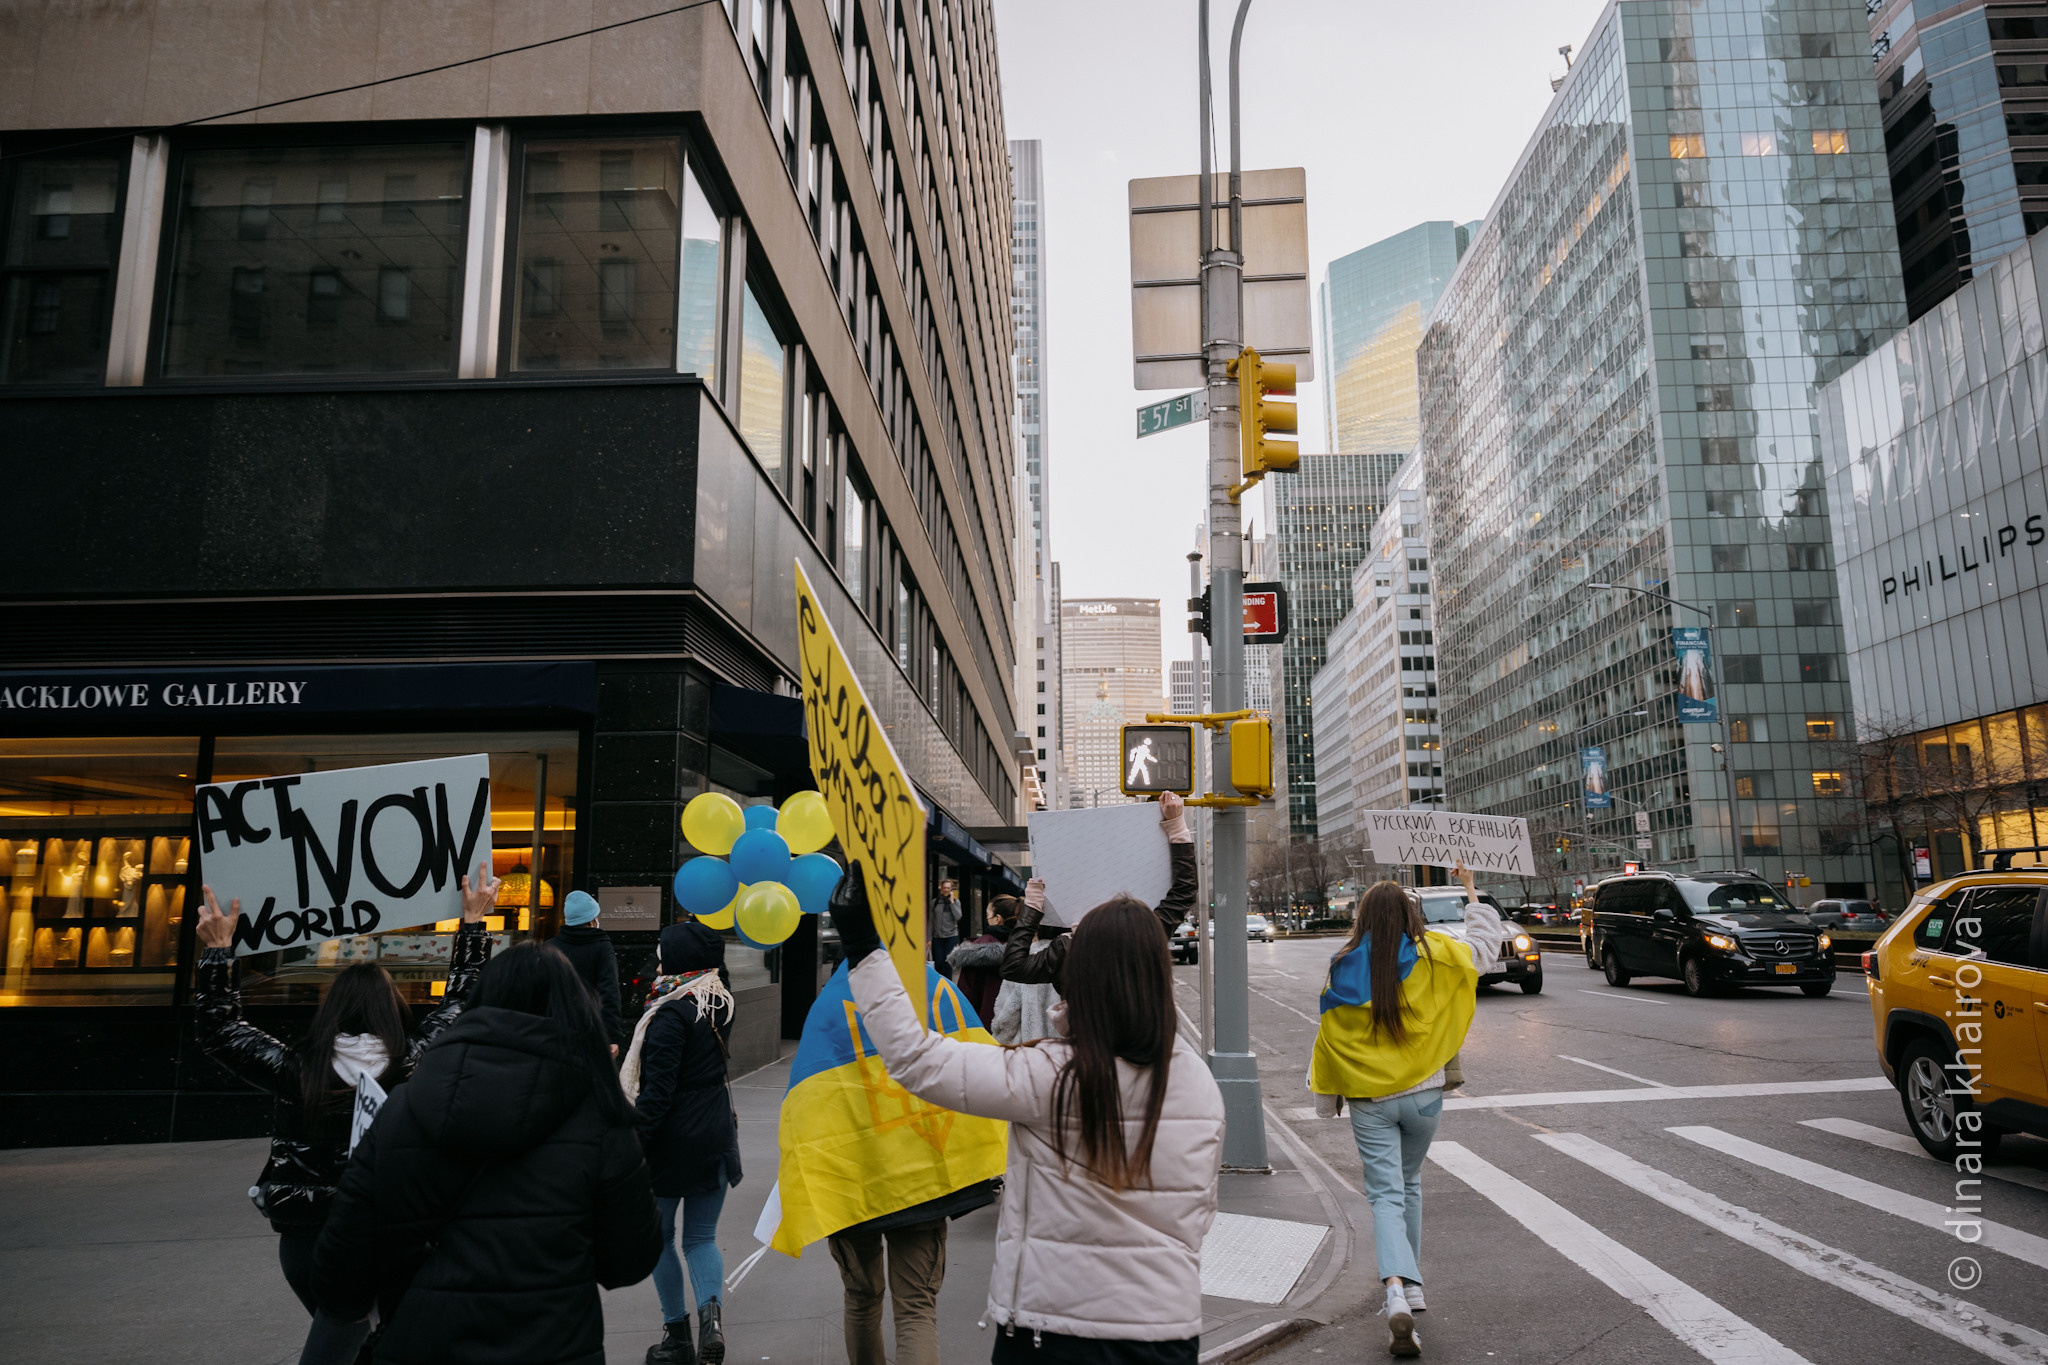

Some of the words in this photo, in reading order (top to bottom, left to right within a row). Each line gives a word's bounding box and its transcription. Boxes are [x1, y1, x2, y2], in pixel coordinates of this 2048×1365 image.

[1139, 410, 1147, 434] E
[1153, 403, 1171, 431] 57
[1175, 397, 1189, 412] ST
[1882, 514, 2046, 604] PHILLIPS
[1079, 603, 1118, 614] MetLife
[162, 681, 308, 707] GALLERY
[1372, 811, 1437, 831] РУССКИЙ
[1448, 818, 1524, 841] ВОЕННЫЙ
[1410, 831, 1476, 848] КОРАБЛЬ
[197, 776, 301, 853] ACT
[291, 777, 490, 909] NOW
[1398, 845, 1453, 864] ИДИ
[1458, 845, 1522, 872] НАХУЙ
[231, 896, 381, 957] WORLD
[1928, 921, 1943, 929] curb
